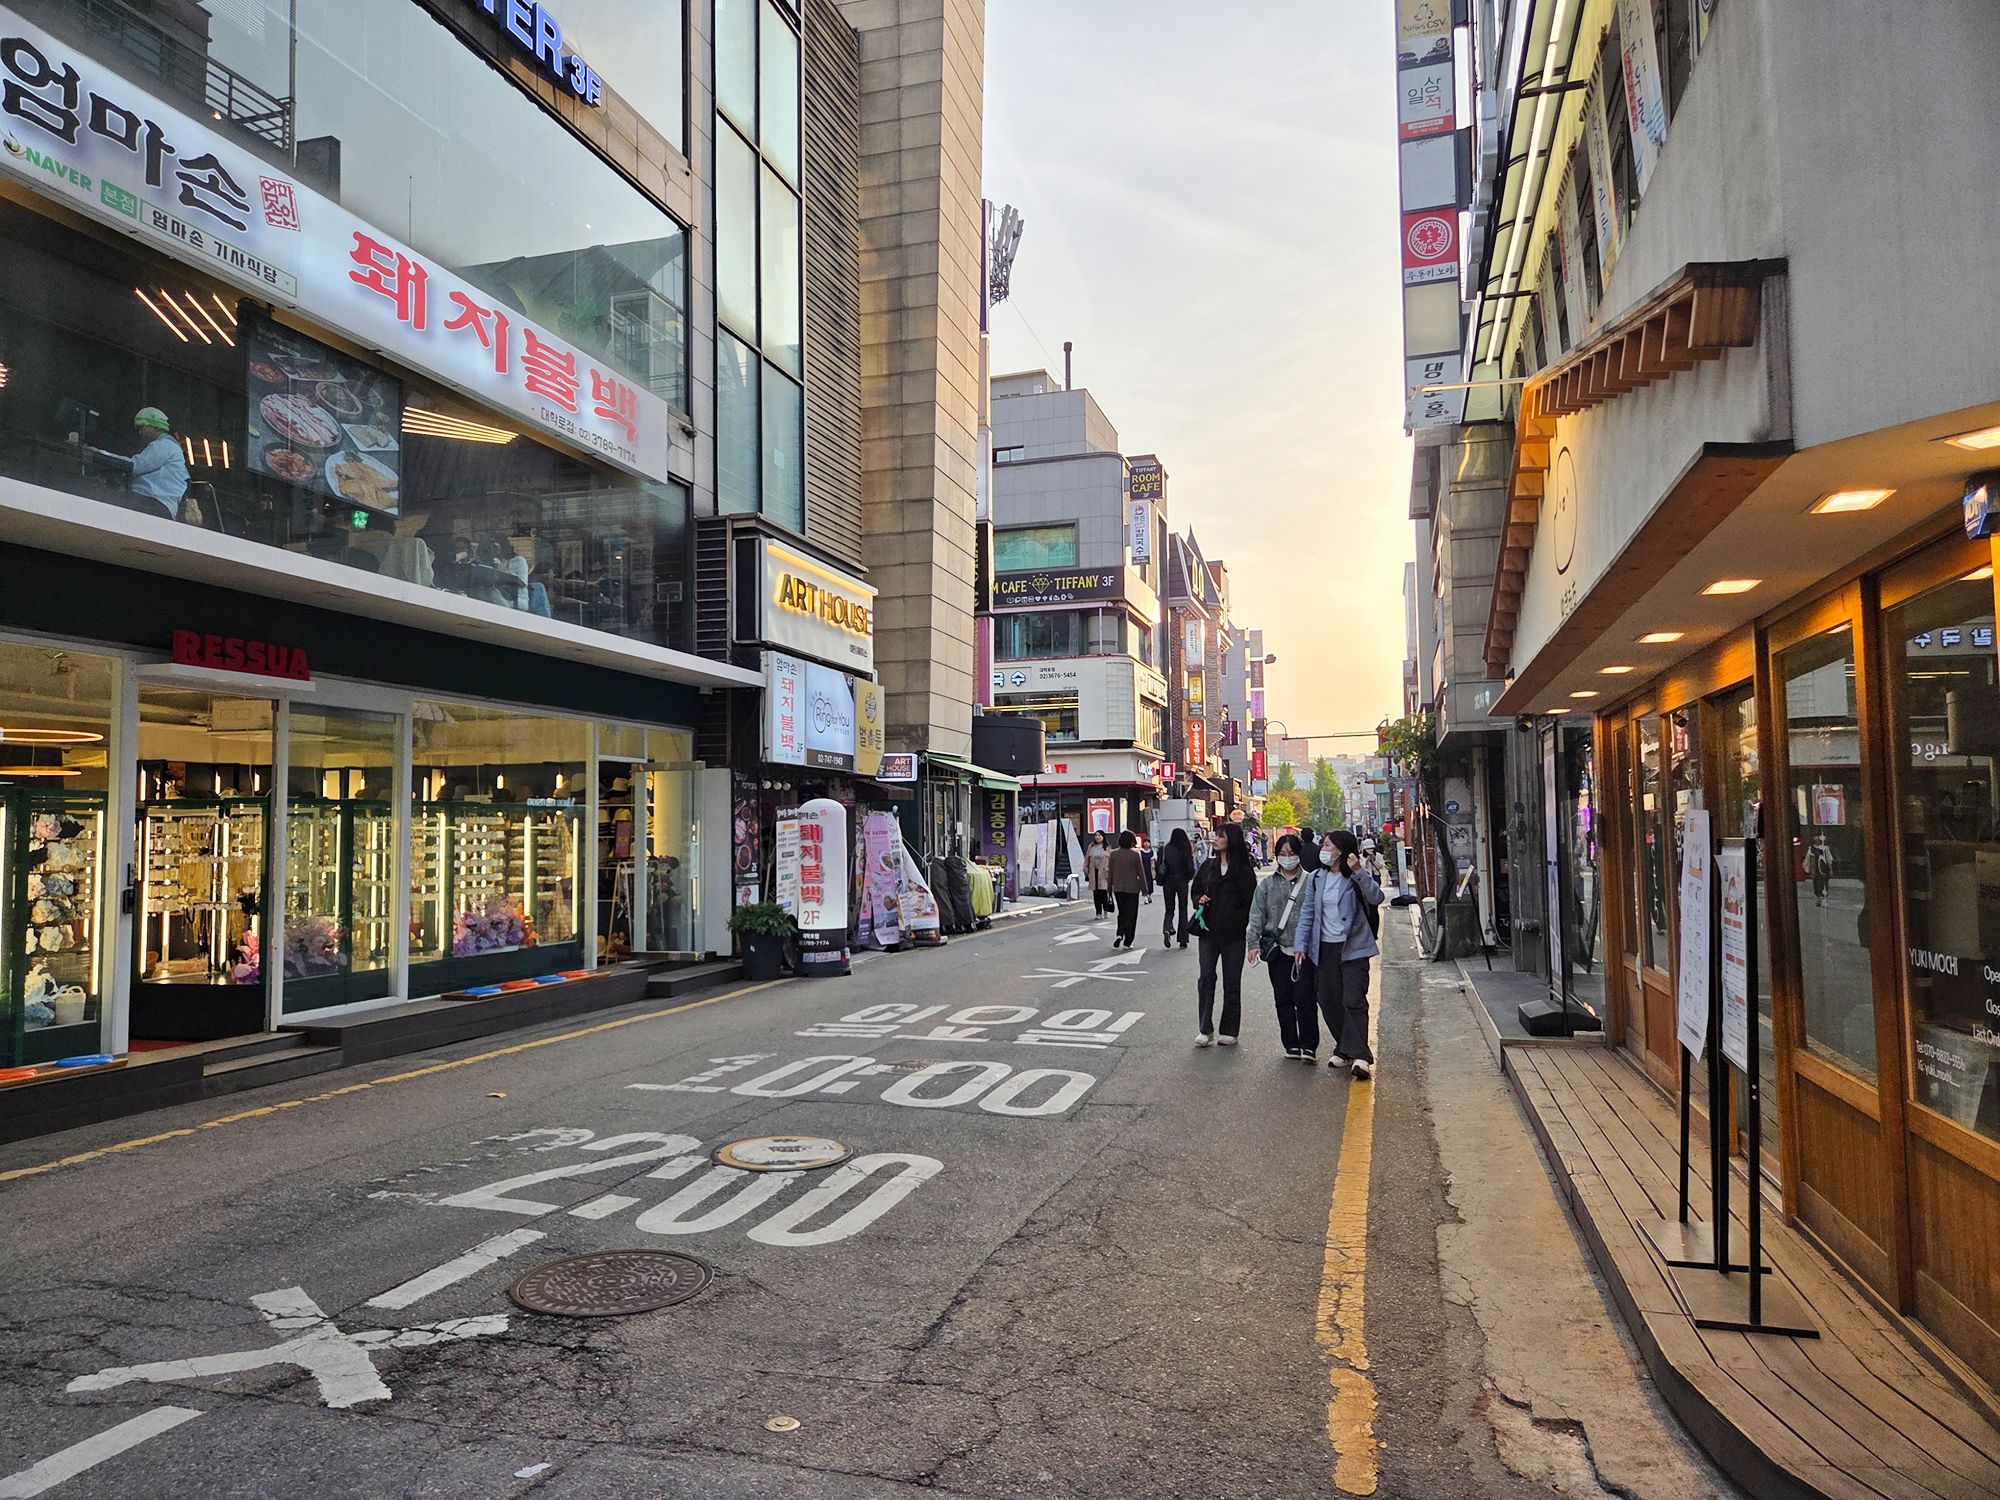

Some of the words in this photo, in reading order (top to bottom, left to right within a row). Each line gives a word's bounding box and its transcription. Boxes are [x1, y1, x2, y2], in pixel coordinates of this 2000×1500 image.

[1426, 17, 1446, 29] CSV
[483, 0, 564, 78] ER
[570, 54, 601, 105] 3F
[0, 37, 250, 232] 엄마손
[25, 146, 94, 193] NAVER
[102, 185, 134, 214] 본점
[152, 209, 204, 249] 엄마손
[213, 240, 278, 285] 기사식당
[349, 230, 639, 443] 돼지불백
[1131, 473, 1160, 484] ROOM
[1131, 482, 1160, 493] CAFE
[779, 573, 818, 613] ART
[819, 588, 873, 636] HOUSE
[1001, 580, 1027, 594] CAFE
[1053, 575, 1100, 590] TIFFANY
[1101, 575, 1115, 588] 3F
[172, 629, 311, 682] RESSUA
[776, 657, 798, 676] 엄마손
[781, 676, 794, 752] 돼지불백
[894, 757, 911, 765] ART
[799, 823, 825, 905] 돼지불백
[803, 910, 820, 925] 2F
[1908, 947, 1928, 969] YUKI
[1928, 953, 1959, 976] MOCHI
[795, 1003, 1146, 1050] 일요일
[1972, 1023, 1986, 1042] Last
[624, 1054, 1097, 1116] 10:00
